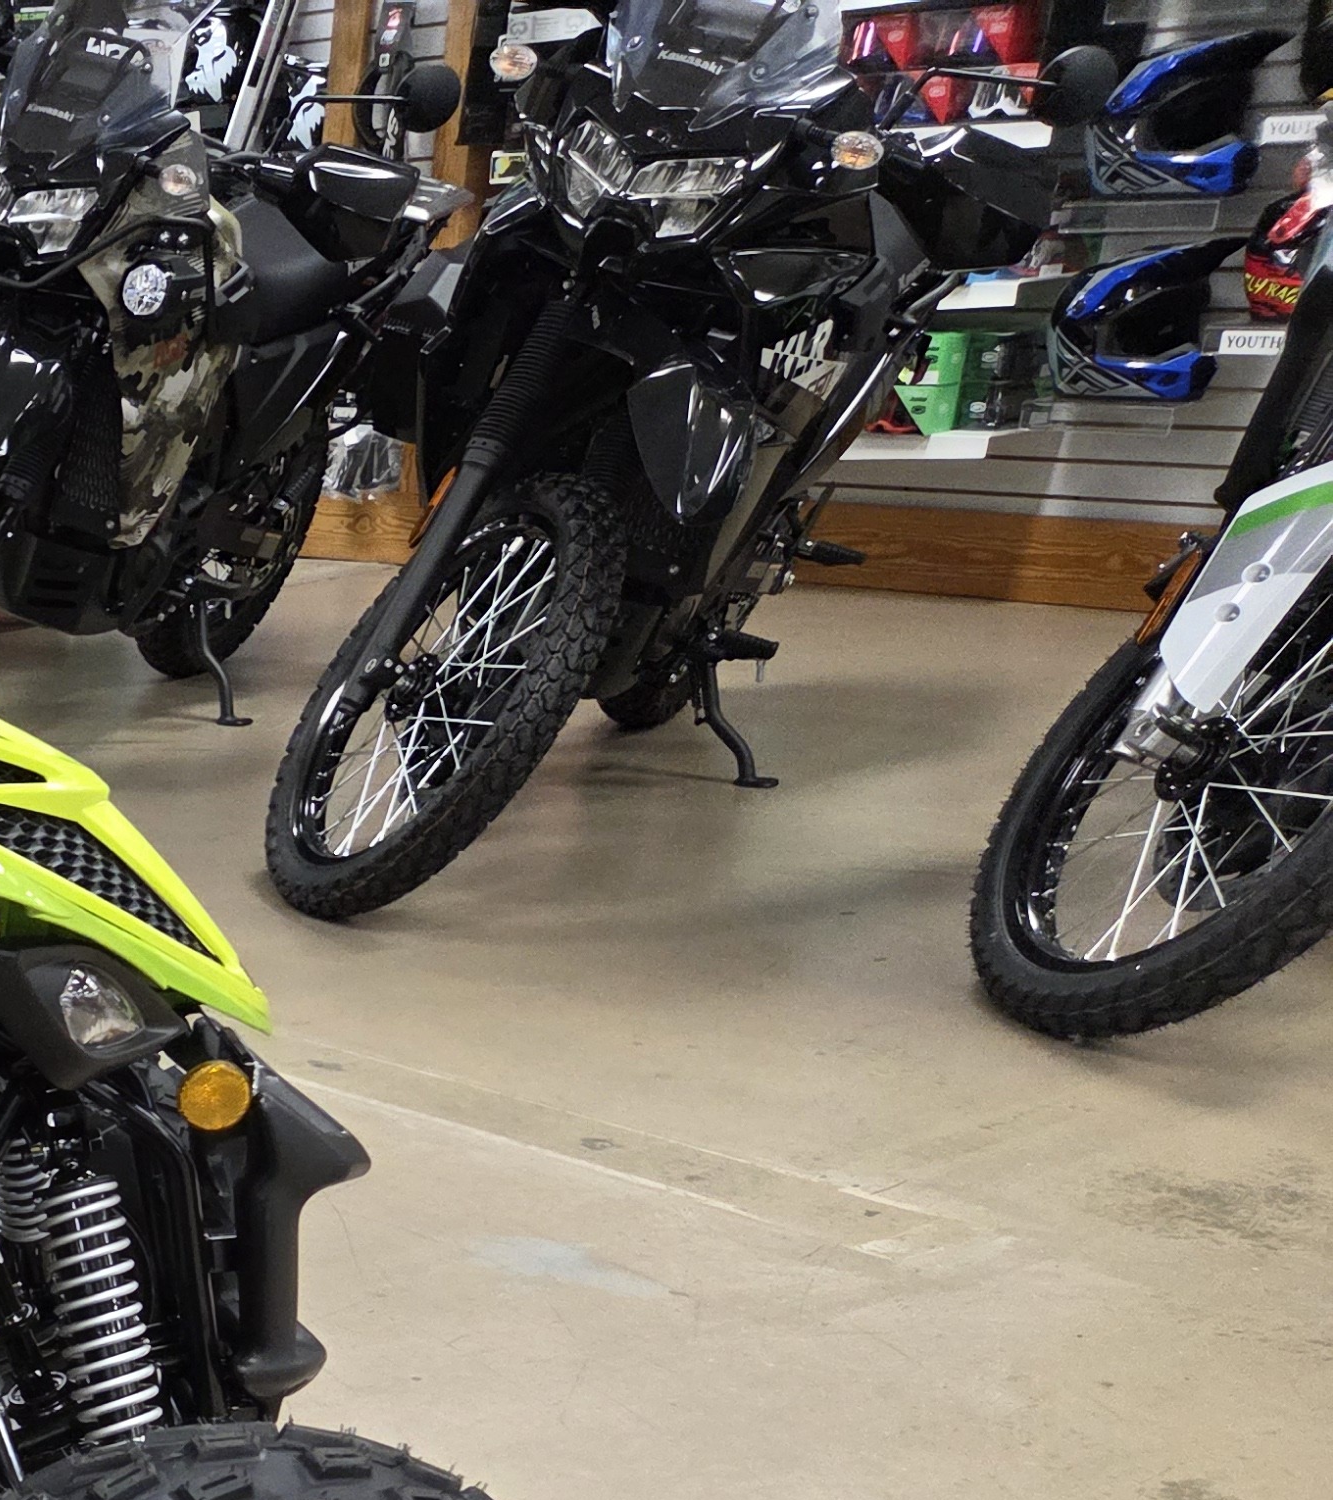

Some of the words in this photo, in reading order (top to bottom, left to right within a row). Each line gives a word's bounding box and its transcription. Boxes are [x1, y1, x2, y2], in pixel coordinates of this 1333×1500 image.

[657, 49, 724, 76] Kawasaki
[1269, 119, 1316, 136] YOUT
[1227, 335, 1283, 349] YOUTH
